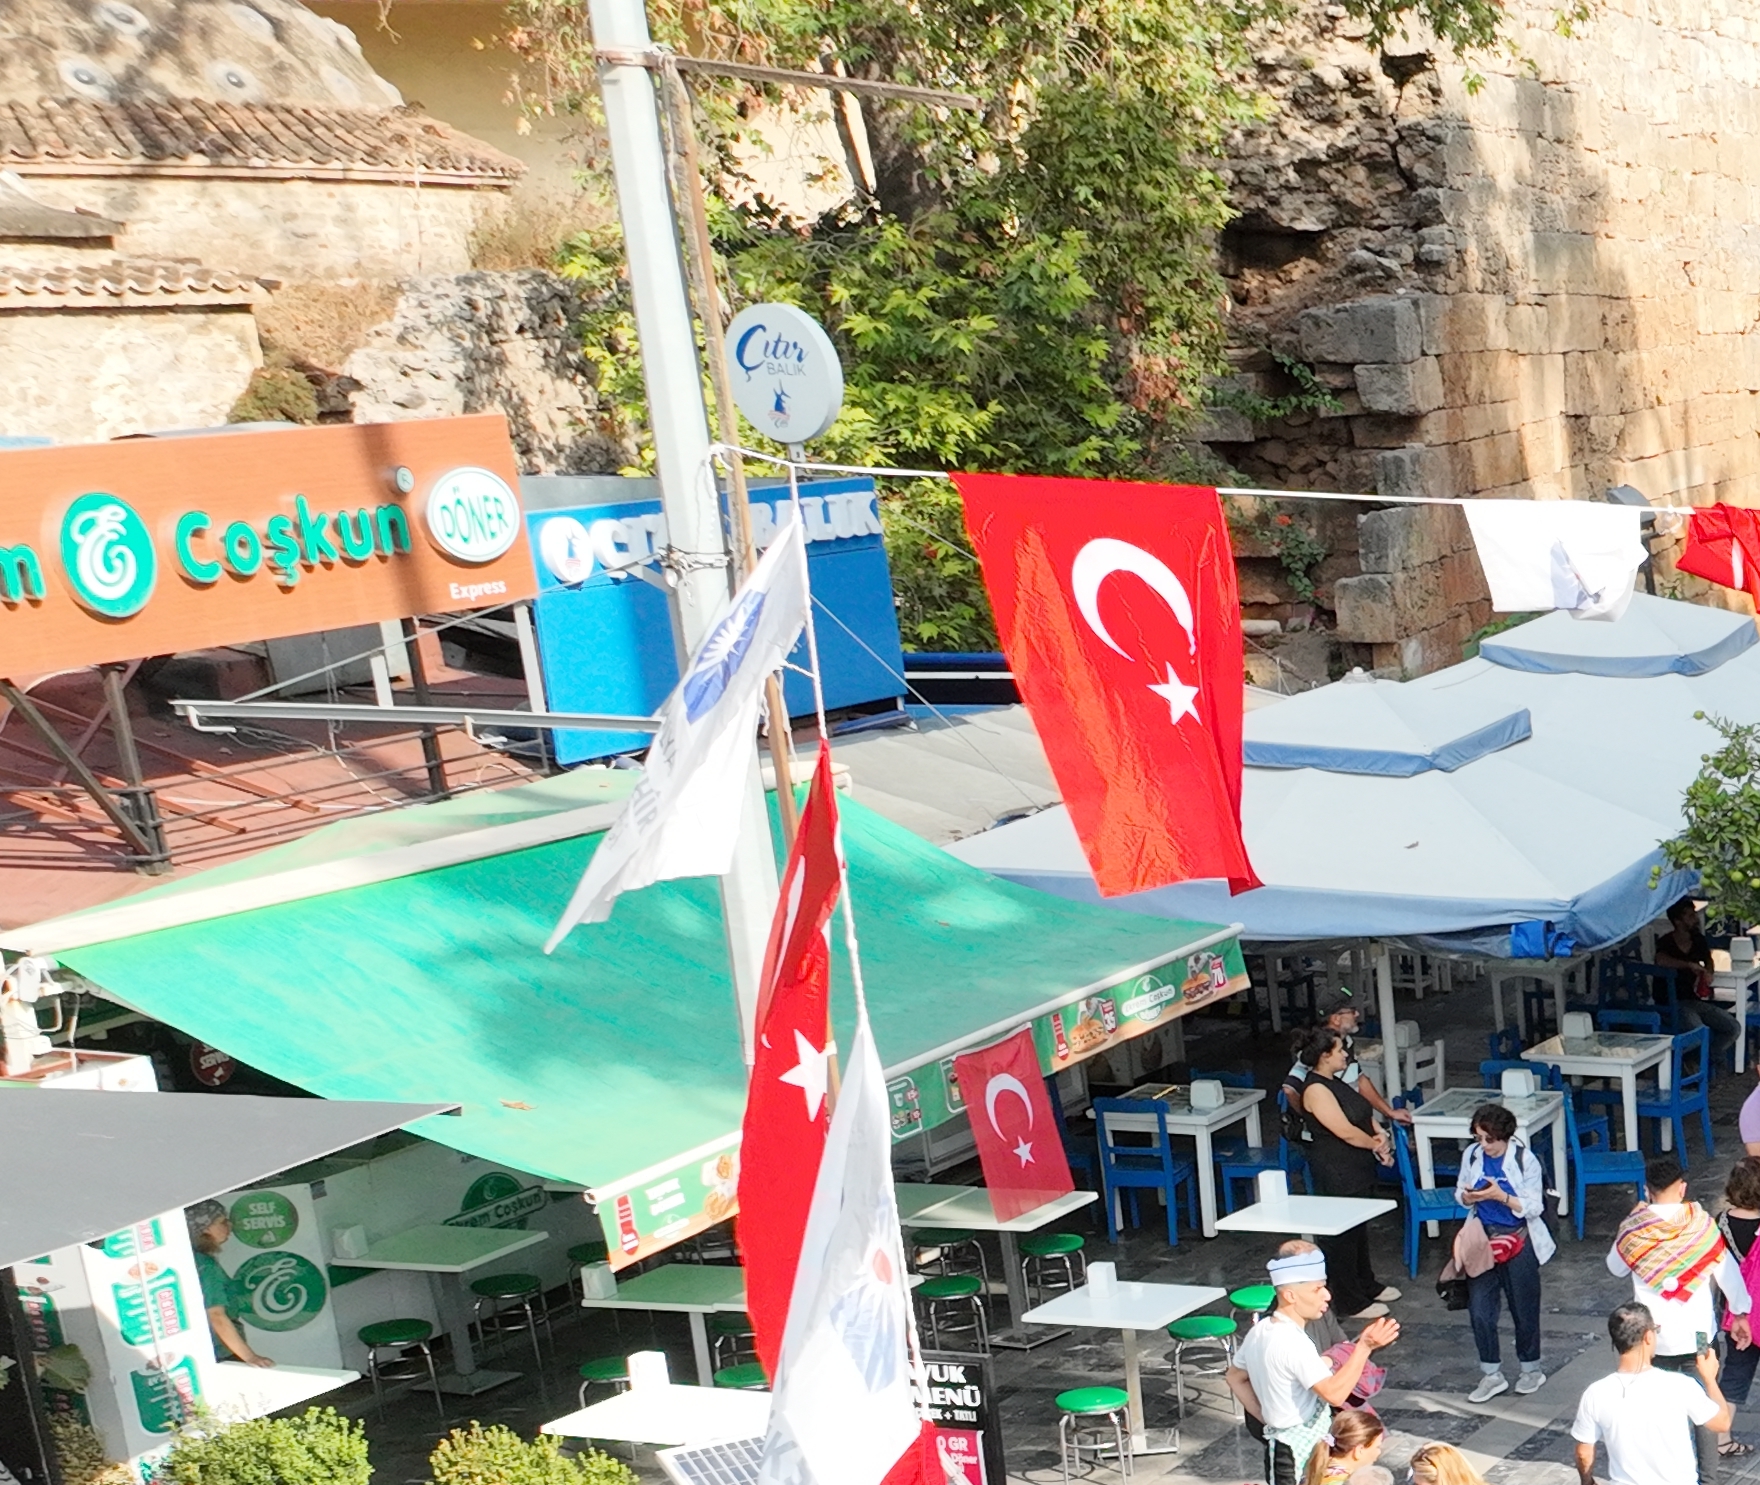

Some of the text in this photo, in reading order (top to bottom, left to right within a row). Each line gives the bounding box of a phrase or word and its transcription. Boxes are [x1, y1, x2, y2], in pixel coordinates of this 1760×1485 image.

[767, 360, 806, 377] BALIK
[438, 486, 509, 545] DÖNER
[175, 494, 412, 586] Coşkun
[449, 579, 507, 600] Express
[249, 1201, 276, 1215] SELF
[243, 1215, 286, 1231] SERVİS
[948, 1436, 968, 1452] GR
